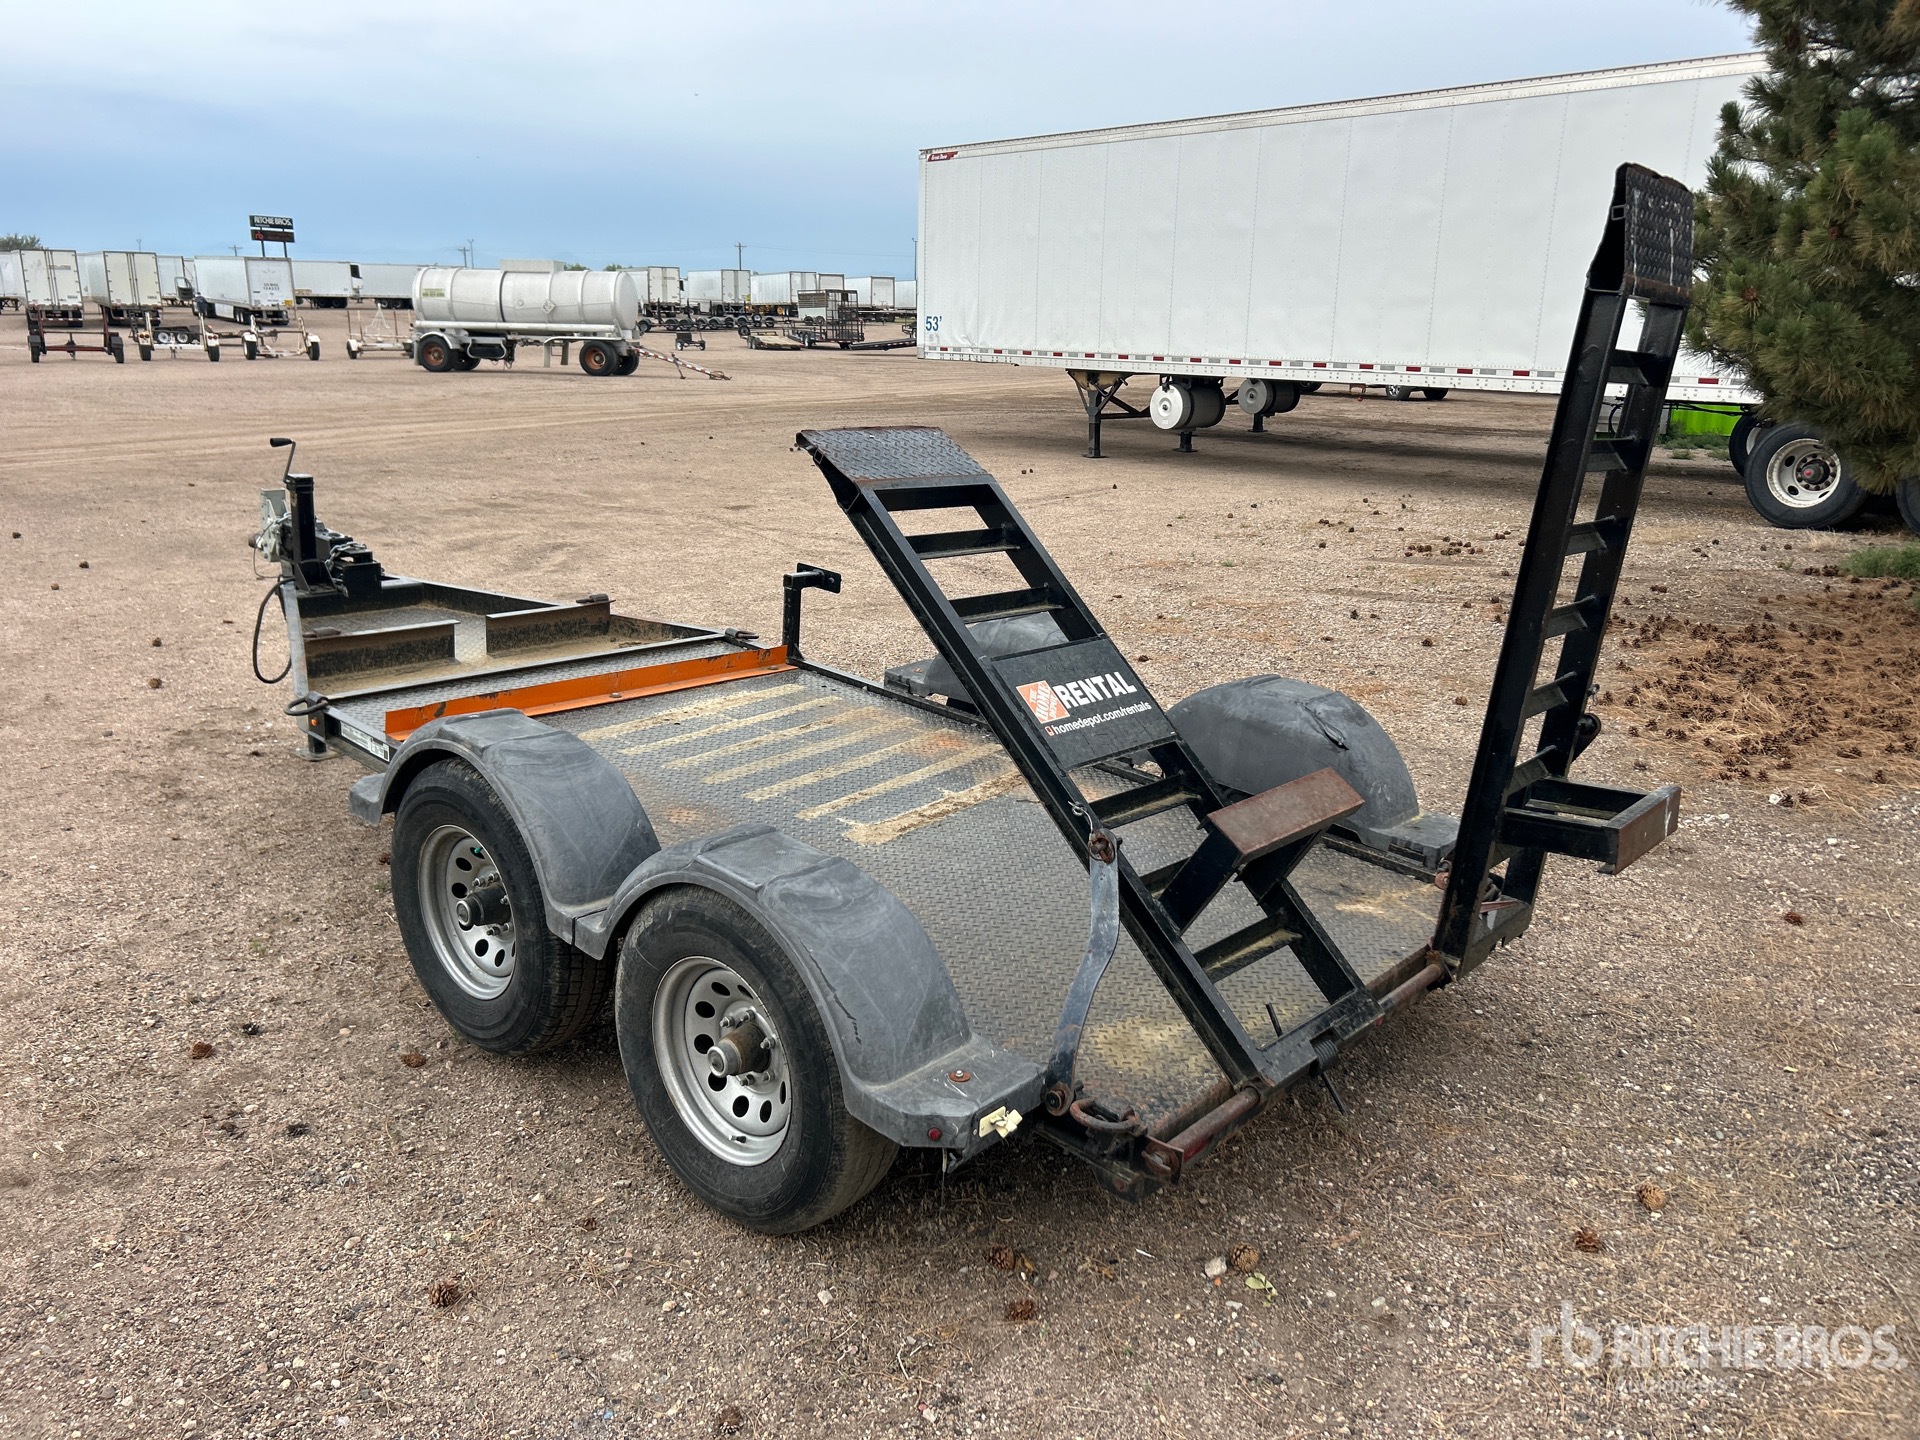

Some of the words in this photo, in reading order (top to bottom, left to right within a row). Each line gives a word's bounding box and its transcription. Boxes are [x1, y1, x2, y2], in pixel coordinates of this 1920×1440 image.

[254, 216, 275, 225] RITCHIE
[1052, 671, 1138, 709] RENTAL
[1052, 700, 1152, 736] homedepot.com/rentals
